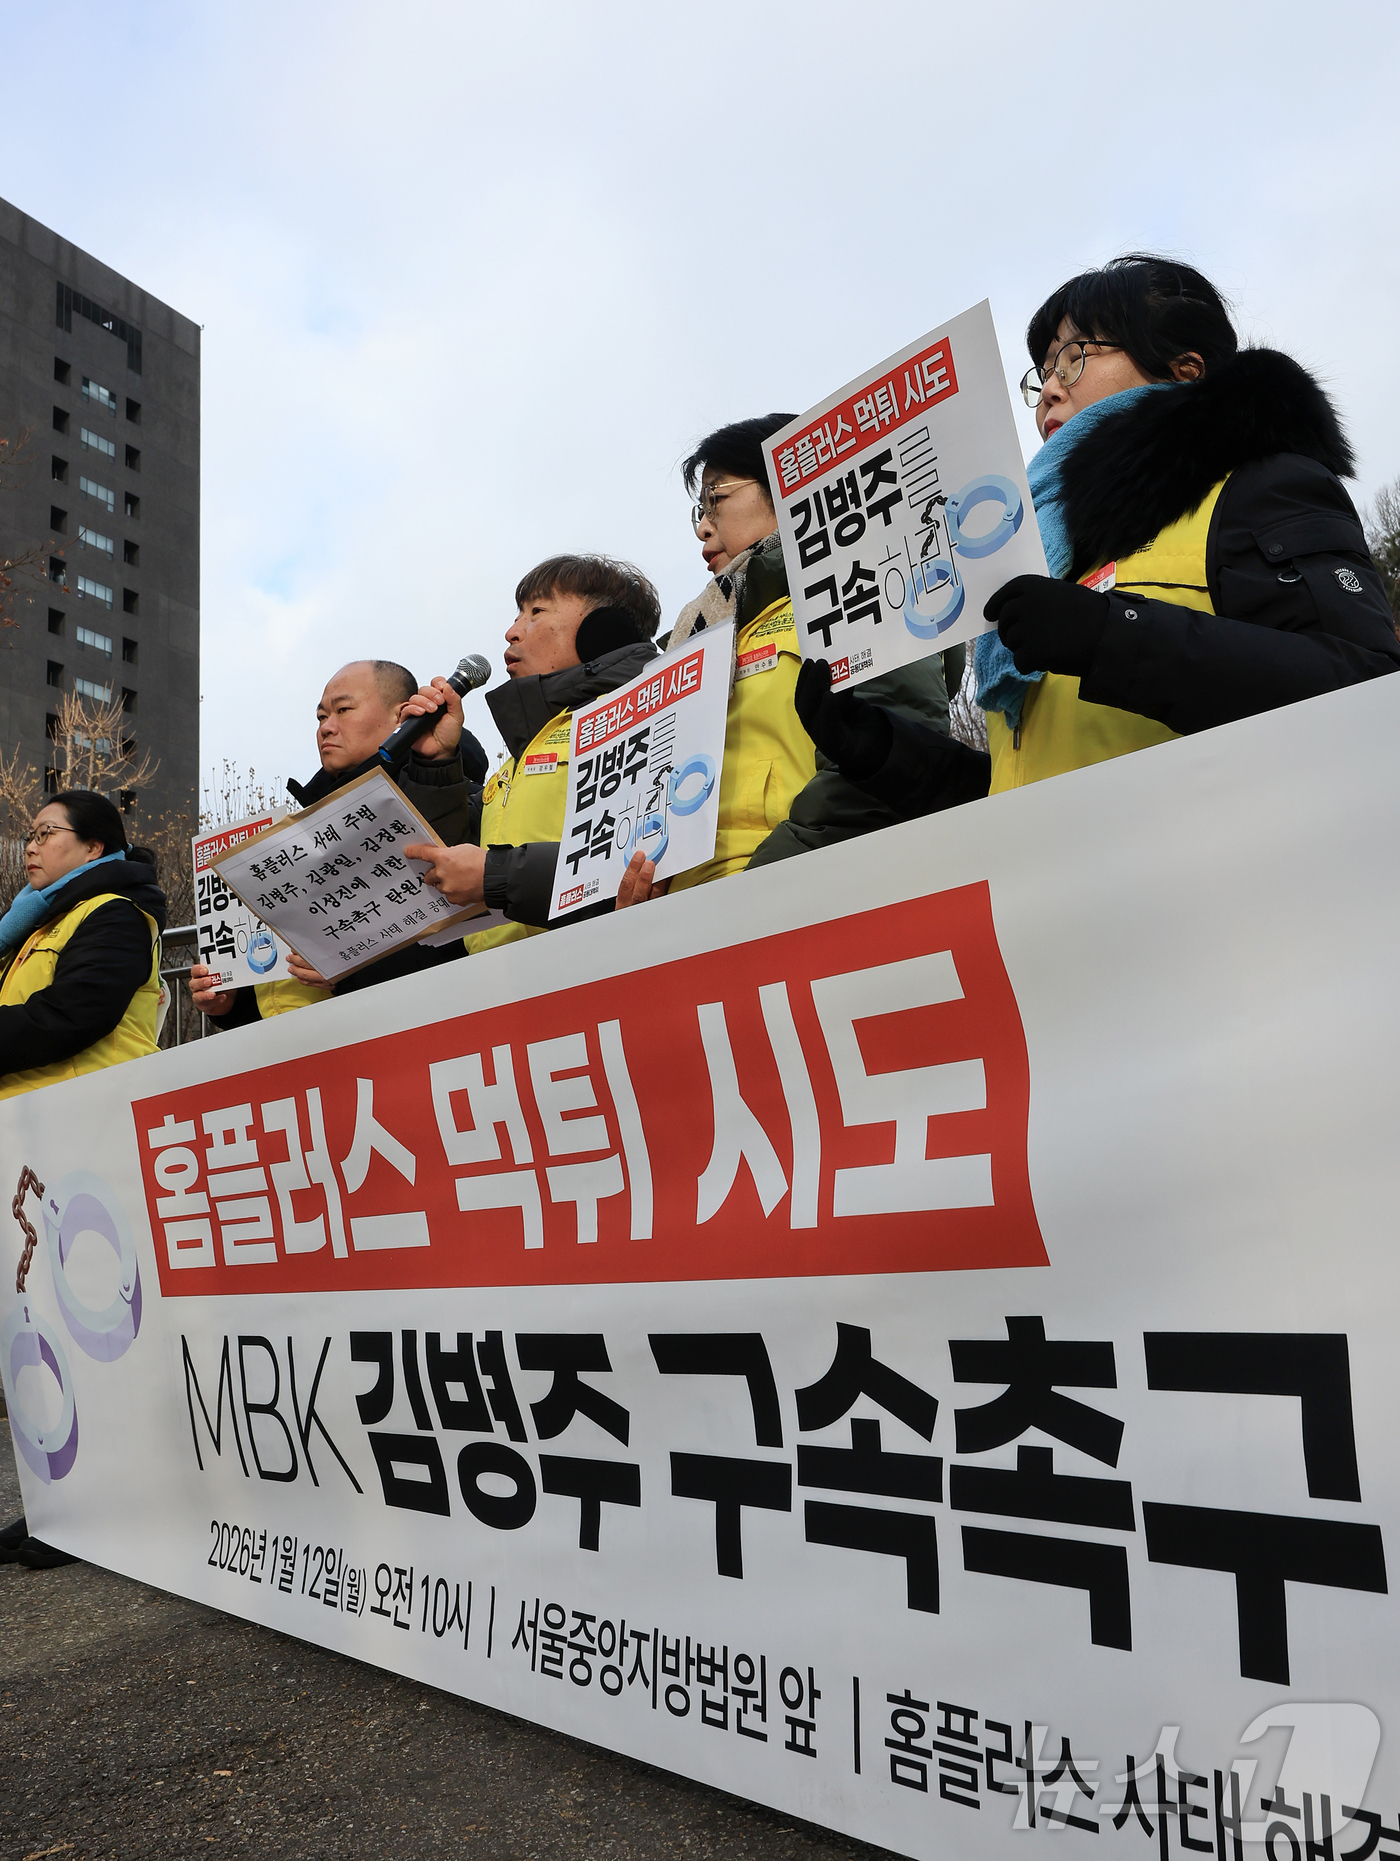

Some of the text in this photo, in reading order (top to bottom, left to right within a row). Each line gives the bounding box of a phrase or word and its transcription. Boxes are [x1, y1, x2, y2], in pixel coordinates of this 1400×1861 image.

[777, 351, 951, 489] 홈플러스 먹튀 시도
[789, 426, 943, 570] 김병주를
[804, 514, 959, 648] 구속하라
[578, 698, 634, 749] 홈플러스
[637, 677, 664, 714] 먹튀
[666, 658, 699, 699] 시도
[831, 662, 849, 680] 러스
[575, 713, 676, 813] 김병주를
[249, 804, 378, 882] 홈플러스 사태 주범
[256, 819, 417, 911] 김병주, 김광일, 김정환,
[565, 779, 672, 876] 구속하라
[198, 874, 243, 917] 김병
[308, 855, 407, 916] 이성진에 대한
[321, 900, 382, 941] 구속촉구
[339, 937, 379, 961] 홈플러스
[380, 923, 403, 939] 사태
[403, 908, 428, 926] 해결
[147, 949, 996, 1270] 홈플러스 먹튀 시도
[181, 1316, 1389, 1687] MBK 김병주 구속촉구
[207, 1520, 267, 1584] 2026년
[270, 1535, 298, 1594] 1월
[301, 1543, 367, 1618] 12일(월)
[370, 1563, 414, 1631] 오전
[421, 1574, 472, 1651] 10시
[511, 1597, 768, 1743] 서울중앙지방법원
[779, 1666, 822, 1759] 앞
[884, 1688, 1100, 1834] 홈플러스
[1112, 1753, 1243, 1861] 사태
